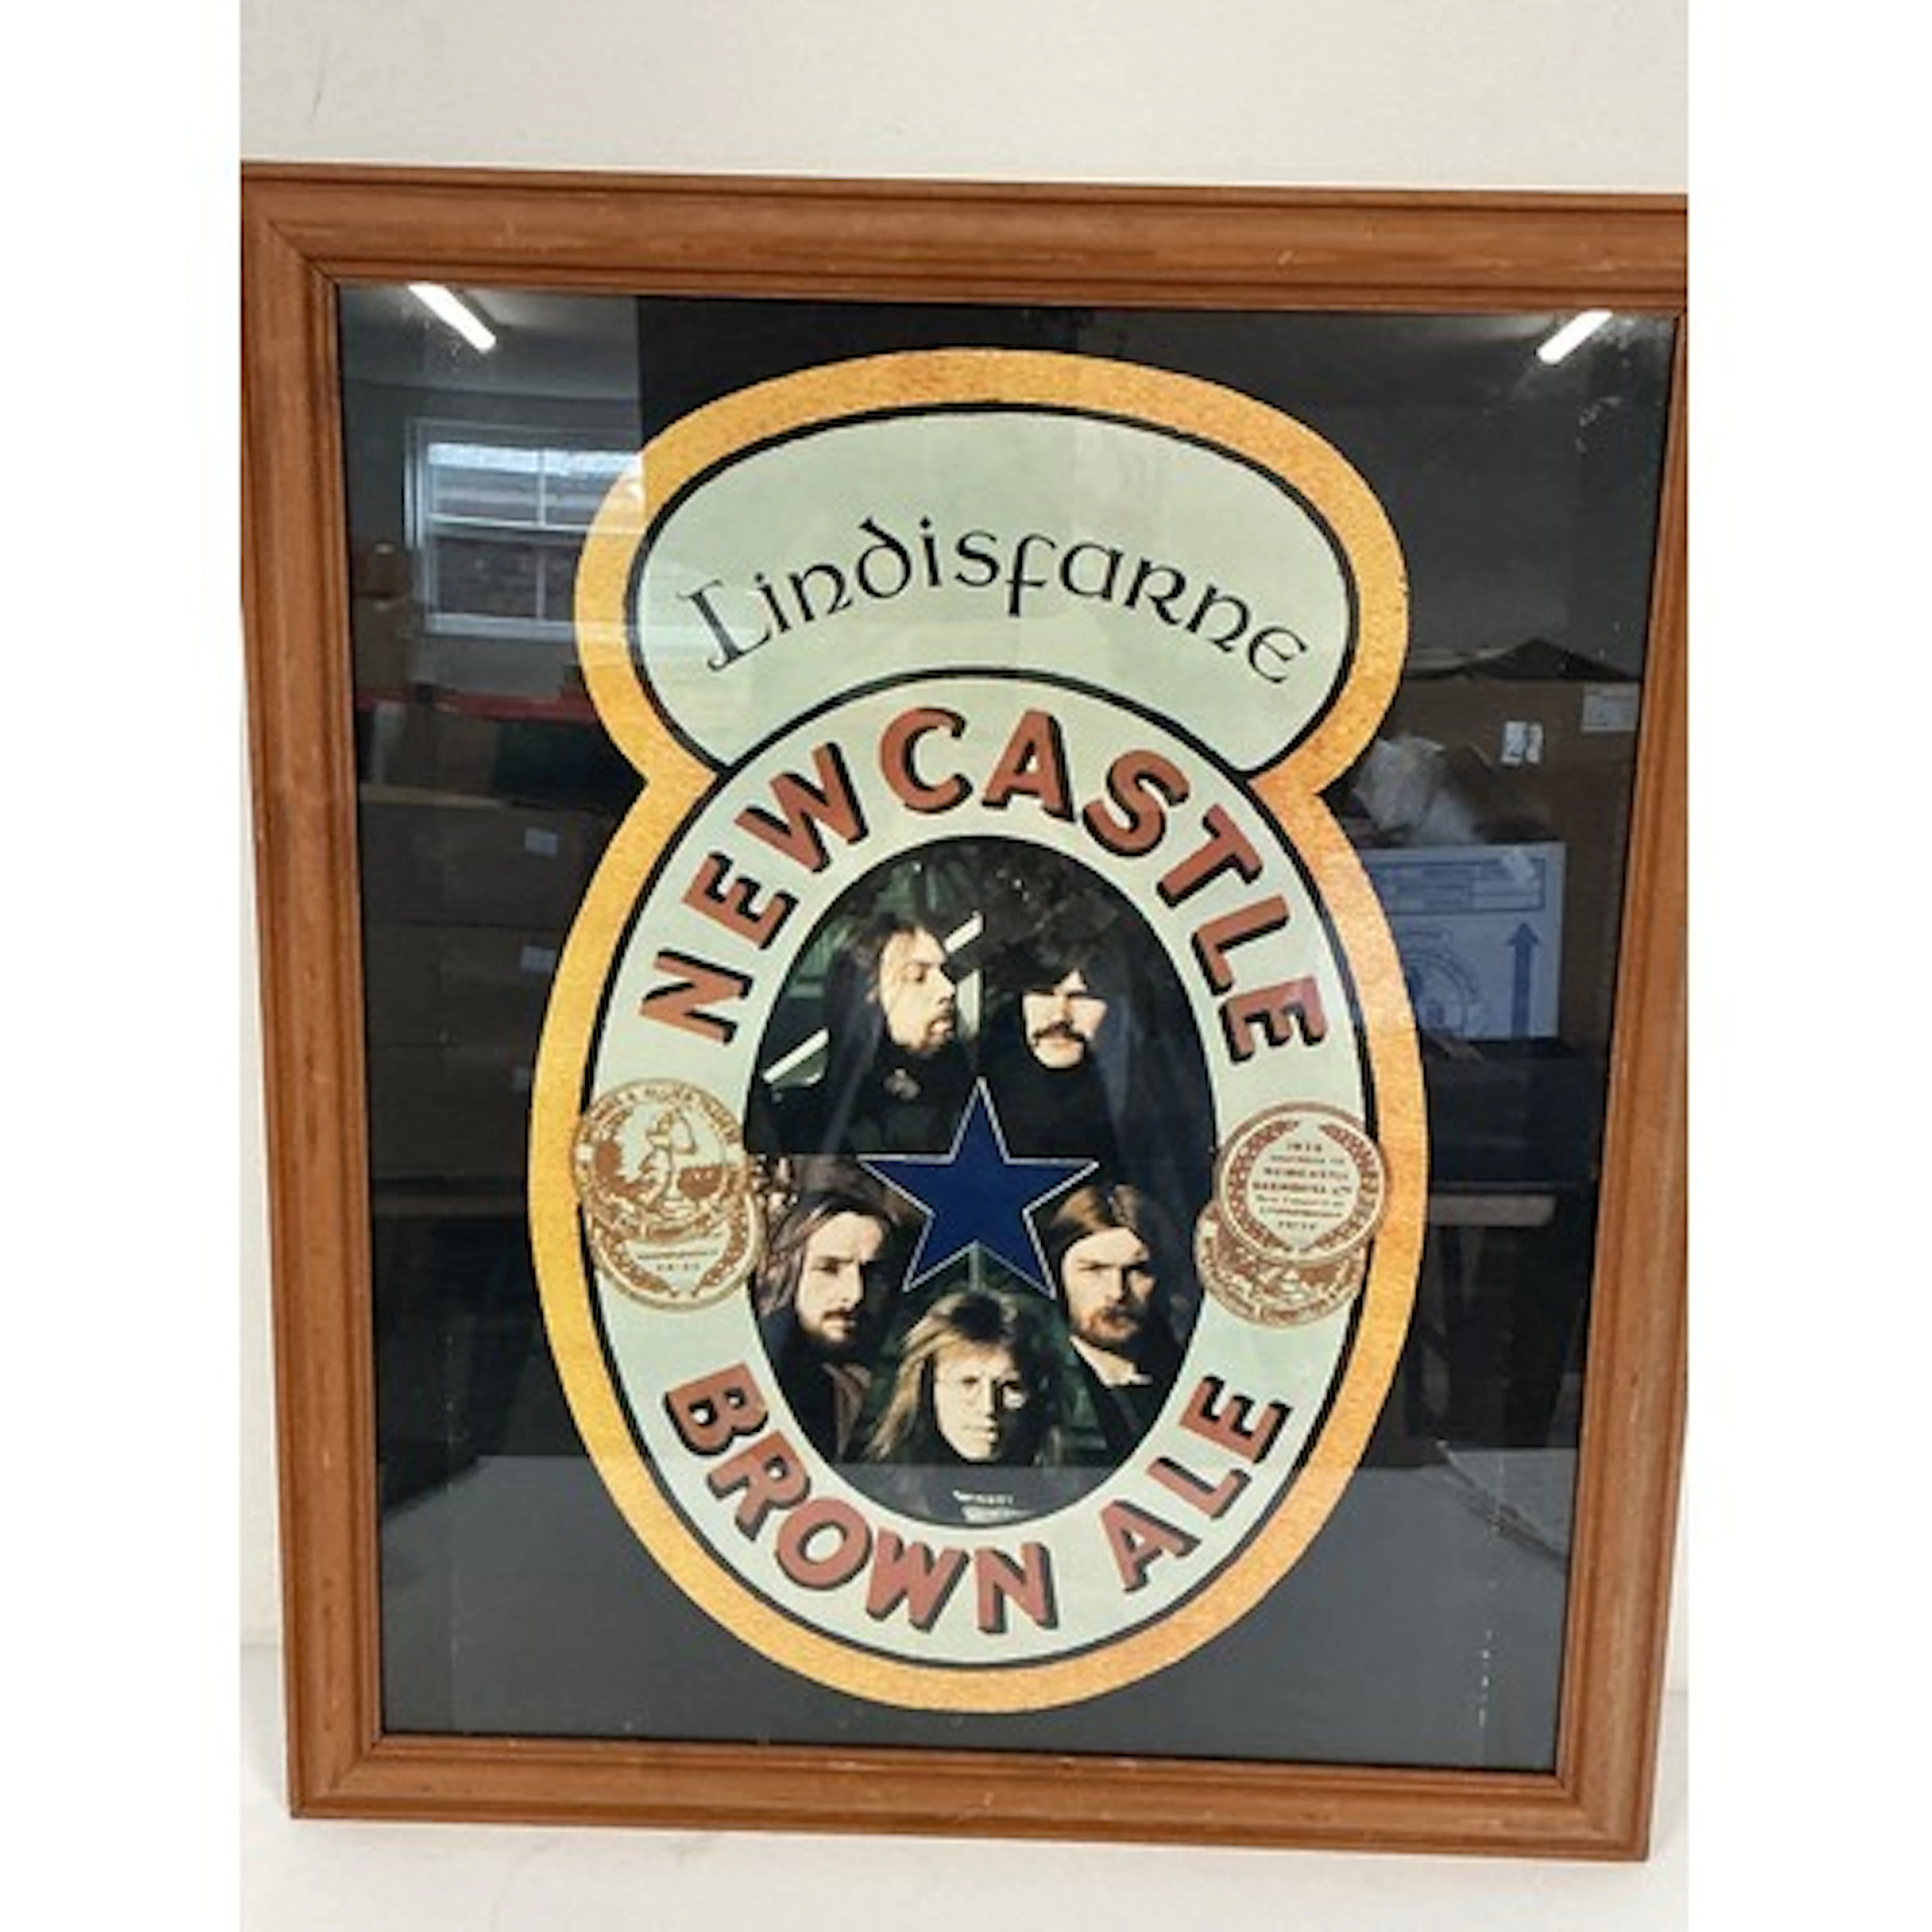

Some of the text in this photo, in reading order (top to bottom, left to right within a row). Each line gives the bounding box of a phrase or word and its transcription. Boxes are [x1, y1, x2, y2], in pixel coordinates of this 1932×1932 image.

[676, 516, 1307, 685] Lindisfarne
[640, 706, 1326, 1062] NEWCASTLE
[664, 1363, 1294, 1634] BROWN ALE
